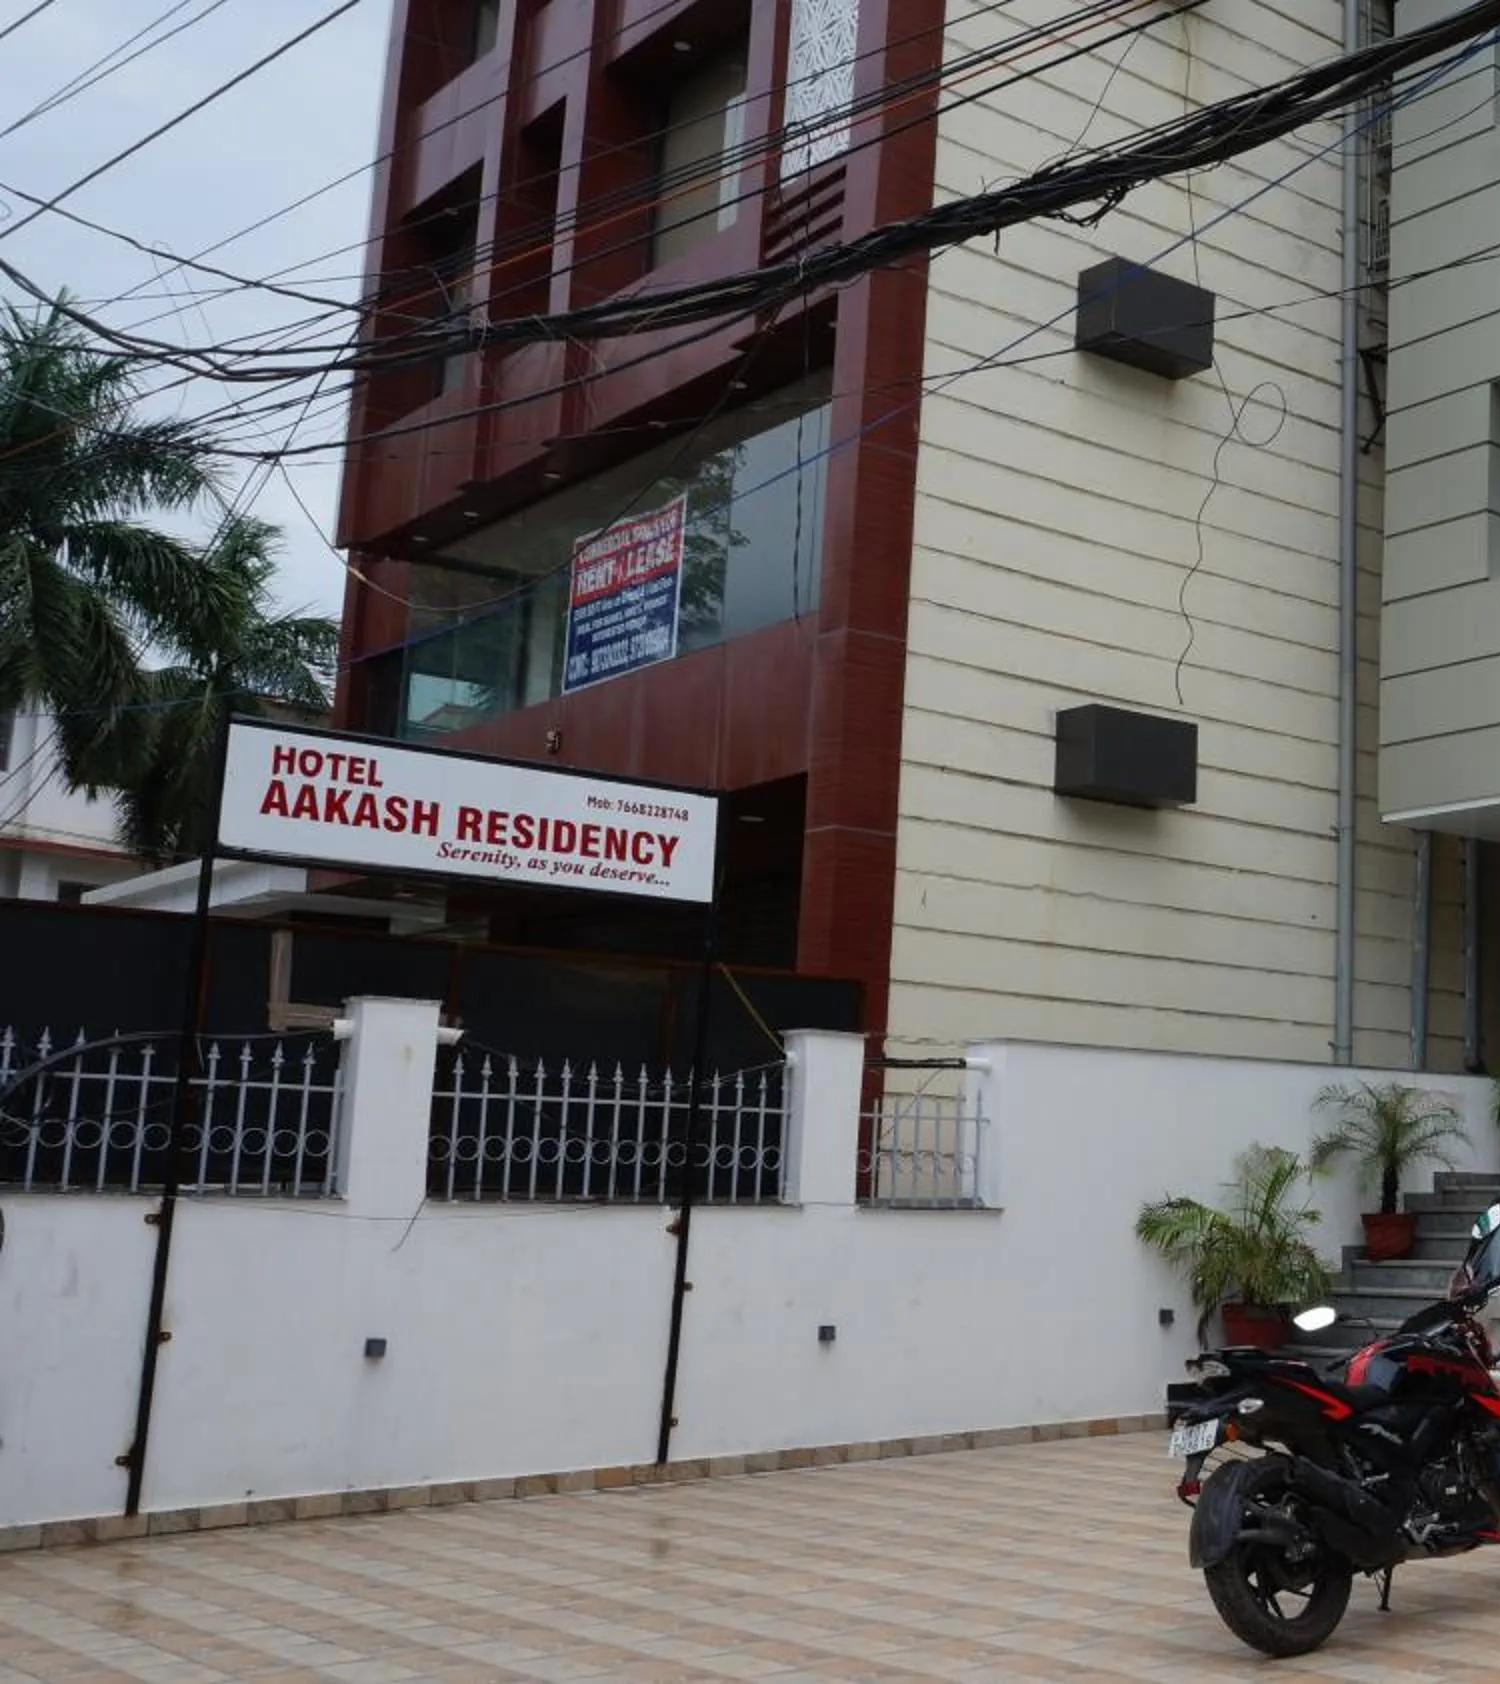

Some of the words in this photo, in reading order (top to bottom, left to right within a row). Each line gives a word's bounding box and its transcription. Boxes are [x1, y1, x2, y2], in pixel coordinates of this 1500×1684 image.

[272, 745, 384, 788] HOTEL
[260, 780, 440, 837] AAKASH
[456, 806, 681, 869] RESIDENCY
[437, 841, 521, 870] Serenity,
[527, 857, 548, 870] as
[550, 860, 584, 875] you
[589, 861, 671, 887] deserve...
